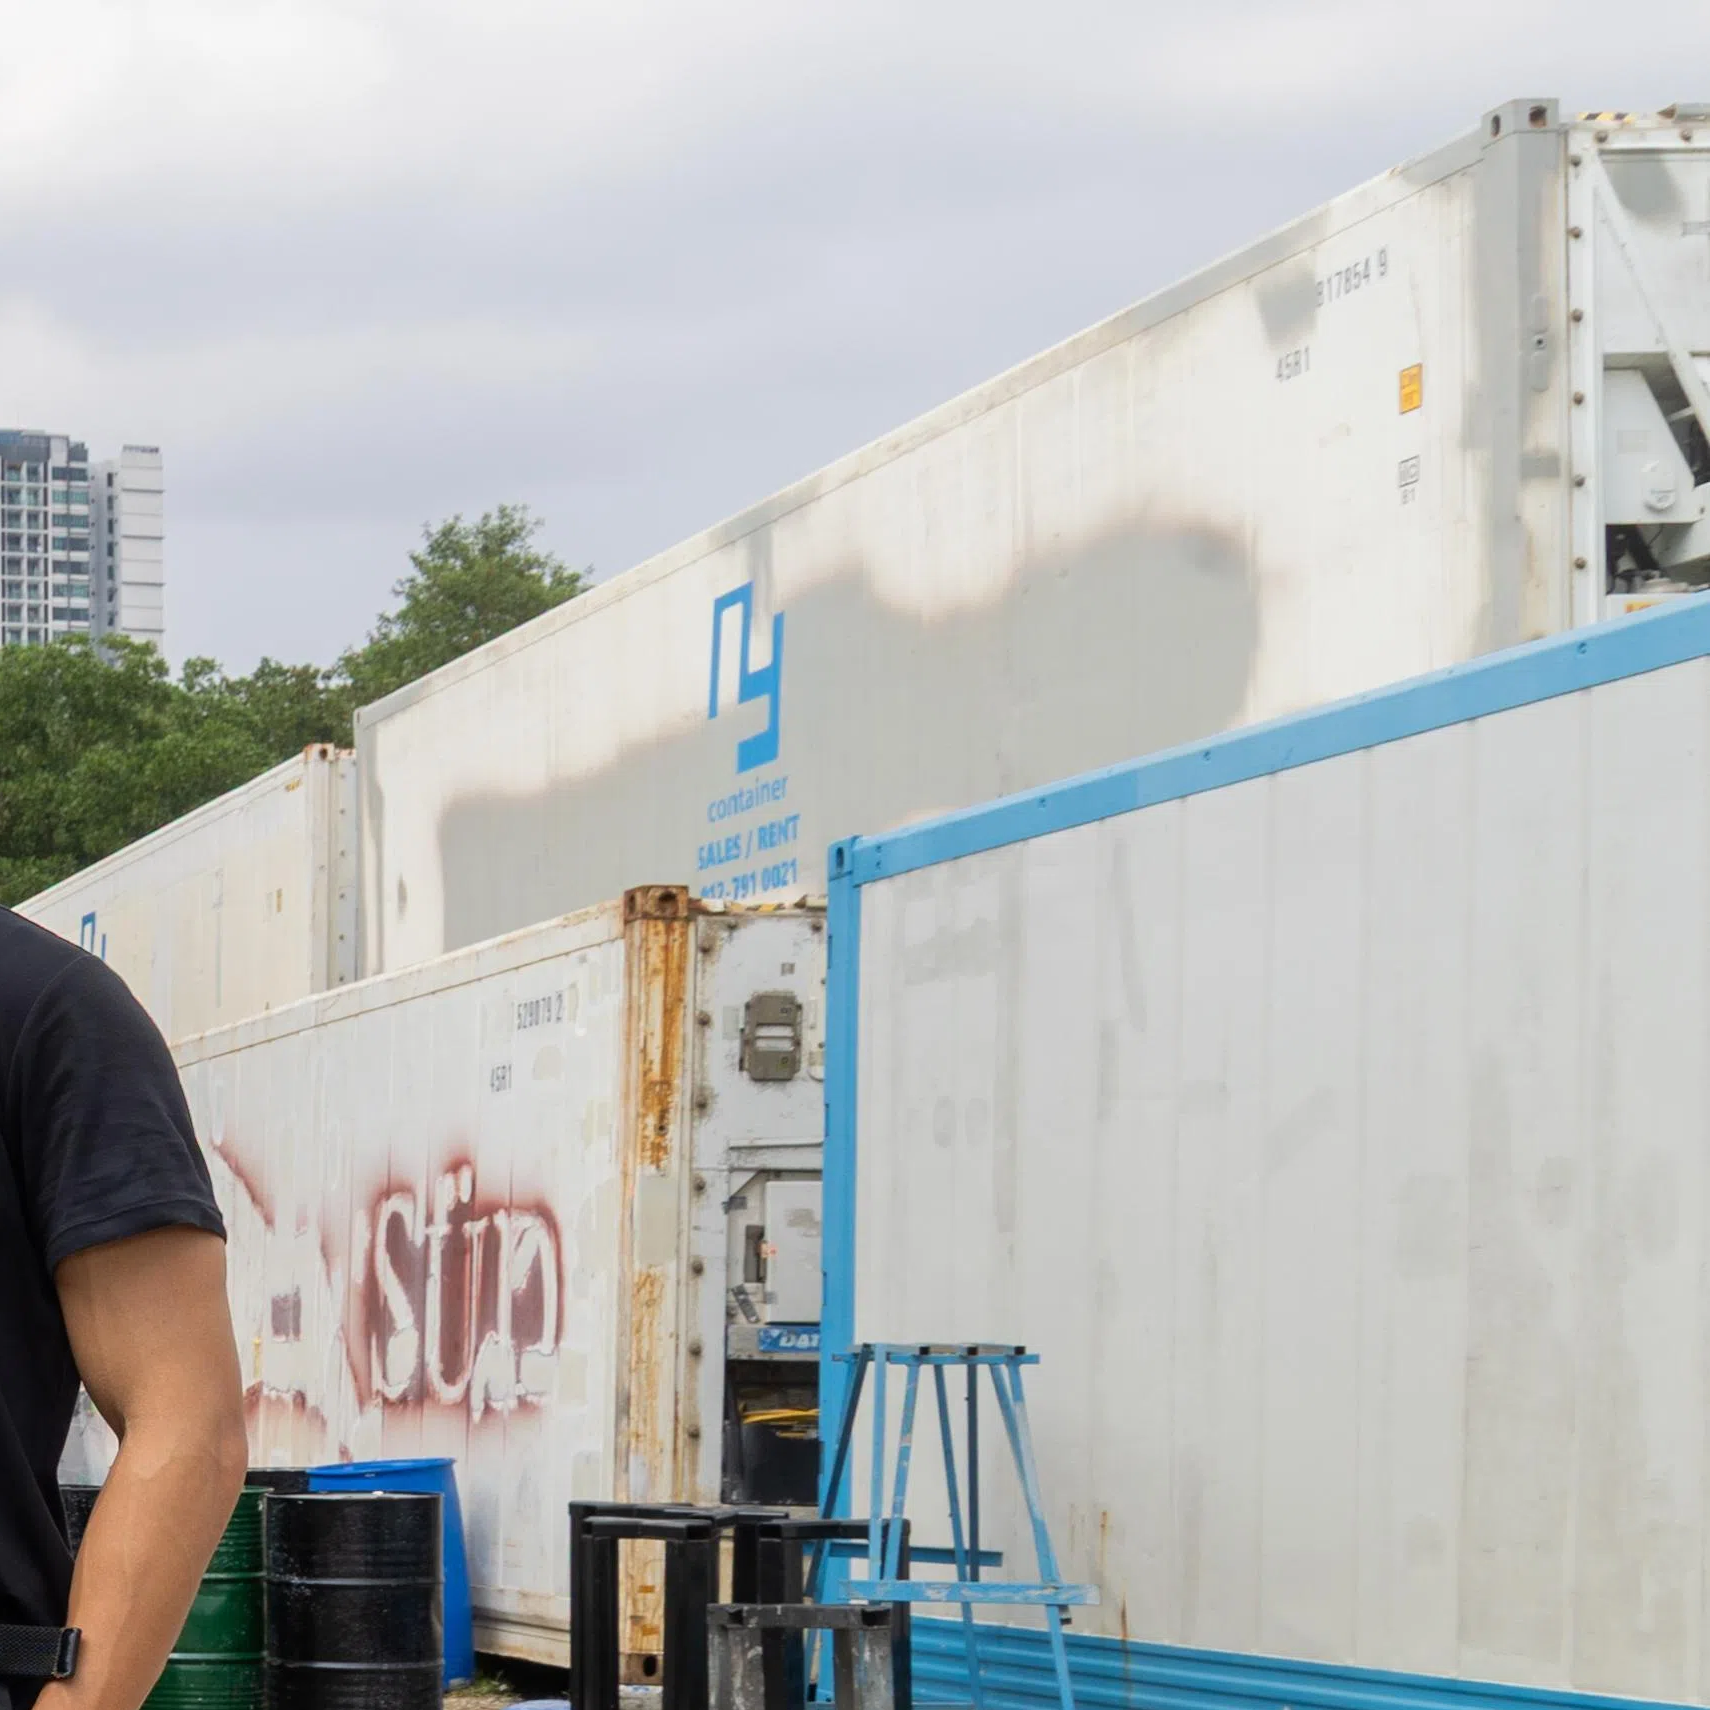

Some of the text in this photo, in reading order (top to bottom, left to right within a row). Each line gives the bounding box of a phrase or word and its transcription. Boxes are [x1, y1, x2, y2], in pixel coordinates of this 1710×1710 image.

[707, 776, 788, 823] container
[698, 813, 801, 871] SALES / RENT
[761, 857, 798, 893] 0021
